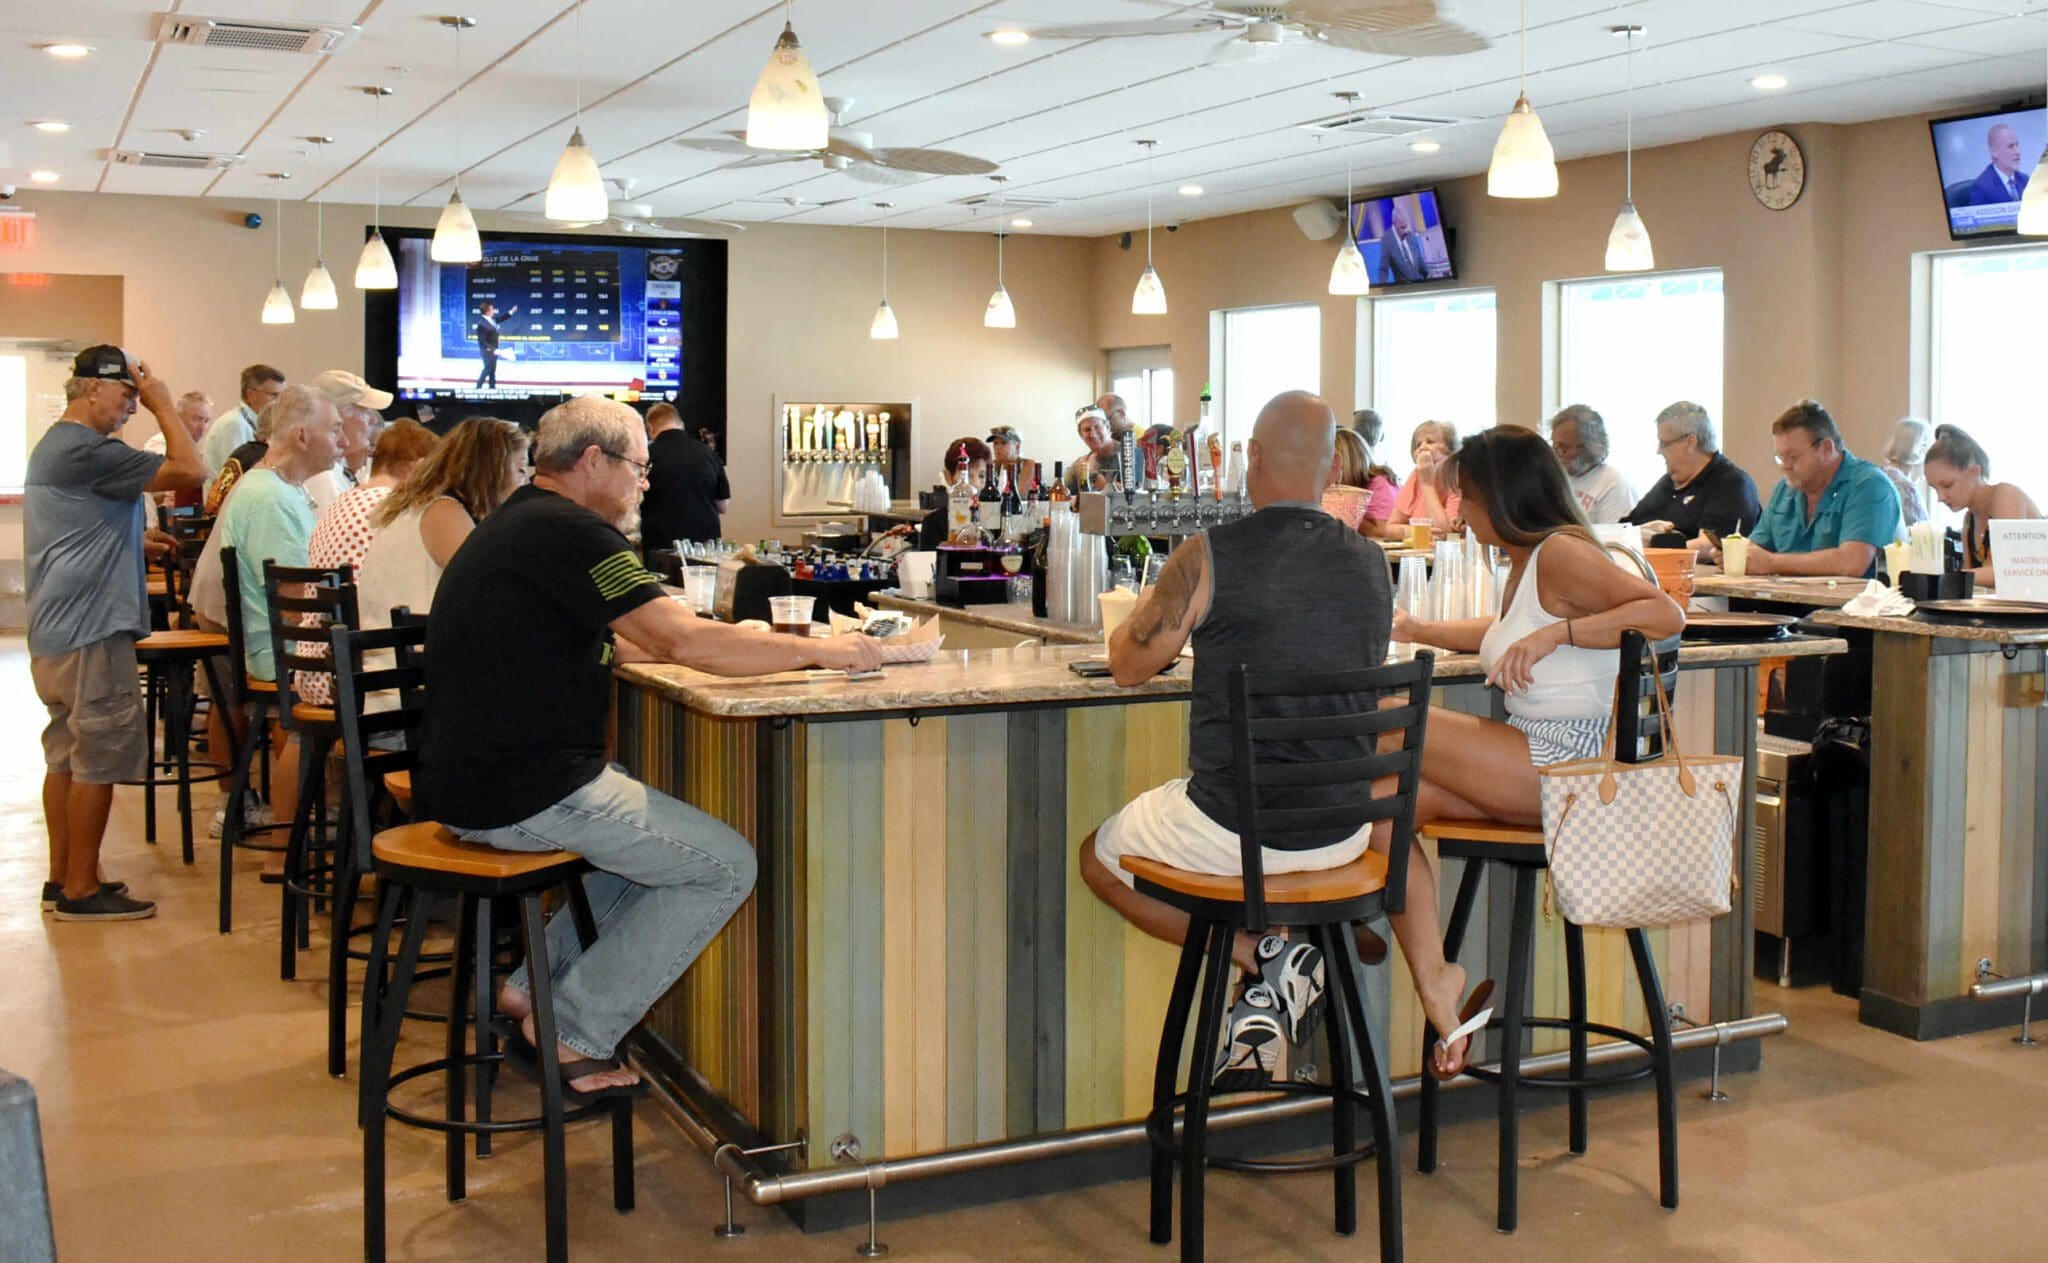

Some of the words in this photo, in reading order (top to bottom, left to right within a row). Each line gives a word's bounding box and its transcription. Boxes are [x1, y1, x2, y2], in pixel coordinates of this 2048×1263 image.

[1123, 435, 1133, 467] LIGHT
[1124, 467, 1134, 490] BUD
[2002, 532, 2047, 541] ATTENTION
[2003, 569, 2034, 577] SERVICE
